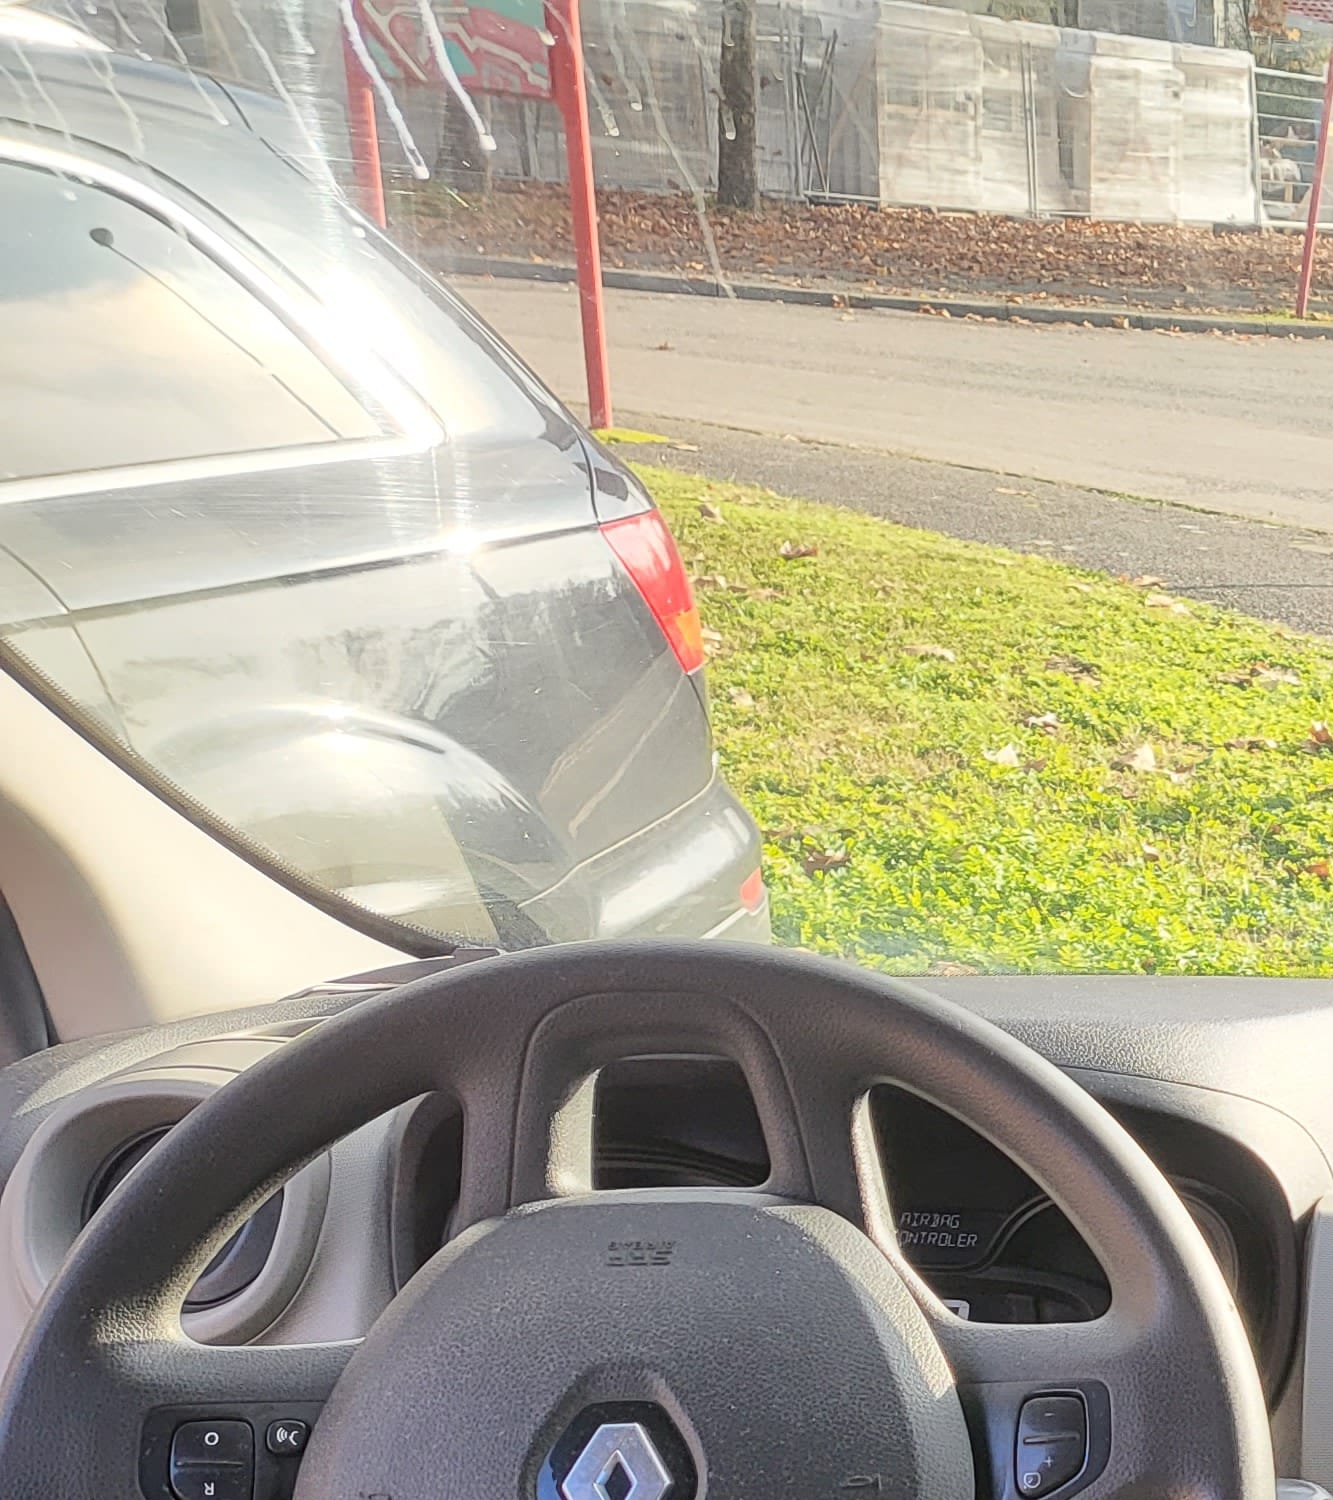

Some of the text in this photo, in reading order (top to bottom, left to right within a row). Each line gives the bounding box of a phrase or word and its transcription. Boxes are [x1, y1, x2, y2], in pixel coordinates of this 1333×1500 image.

[900, 1211, 961, 1229] AIRBAG
[899, 1230, 978, 1248] ONTROLER
[203, 1482, 215, 1496] R
